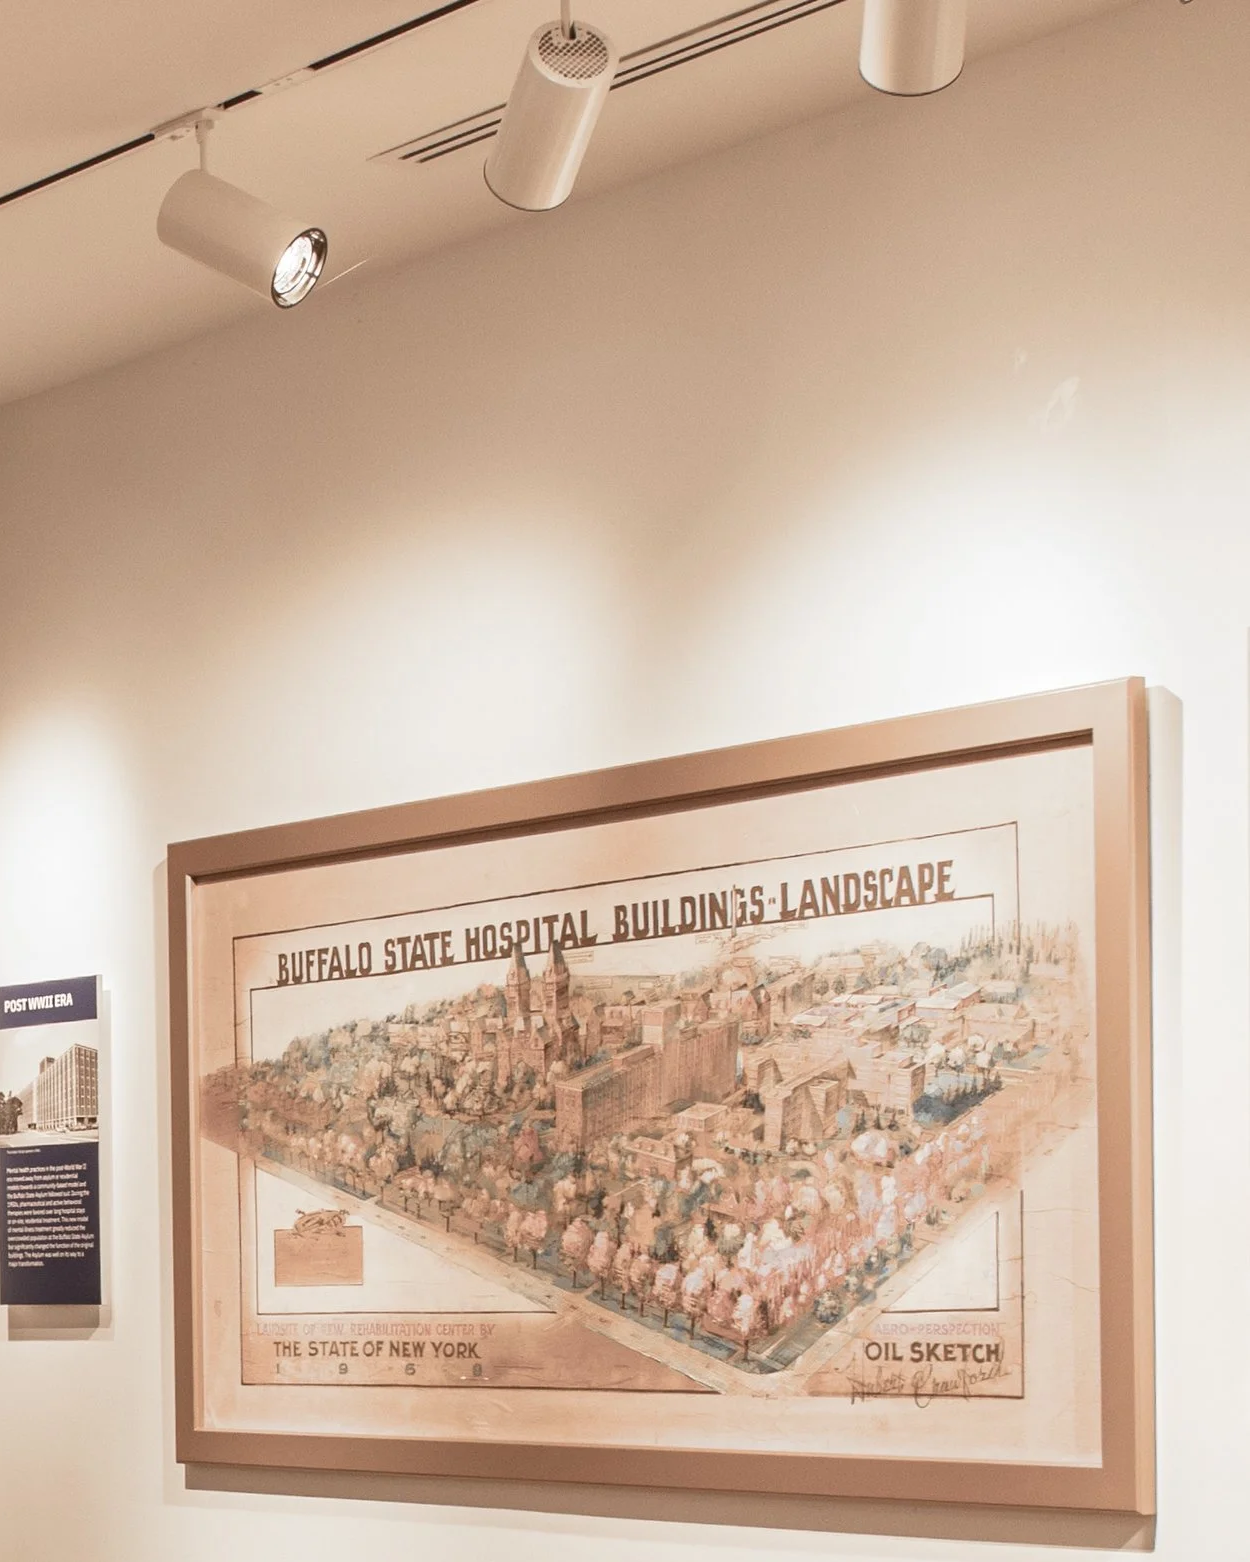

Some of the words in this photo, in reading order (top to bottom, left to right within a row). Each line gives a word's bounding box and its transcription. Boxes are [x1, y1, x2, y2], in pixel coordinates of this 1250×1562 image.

[276, 942, 372, 986] BUFFALO
[384, 930, 454, 974] STATE
[465, 910, 598, 962] HOSPITAL
[4, 998, 28, 1013] POST
[28, 995, 53, 1010] WWII
[54, 993, 73, 1007] ERA
[350, 1323, 430, 1336] REHABILITATION
[436, 1323, 474, 1336] CENTER
[480, 1323, 495, 1336] BY
[273, 1341, 302, 1357] THE
[308, 1341, 358, 1357] STATE
[363, 1341, 384, 1357] OF
[389, 1341, 425, 1357] NEW
[432, 1342, 481, 1359] YORK
[865, 1342, 903, 1362] OIL
[910, 1342, 1000, 1363] SKETCH
